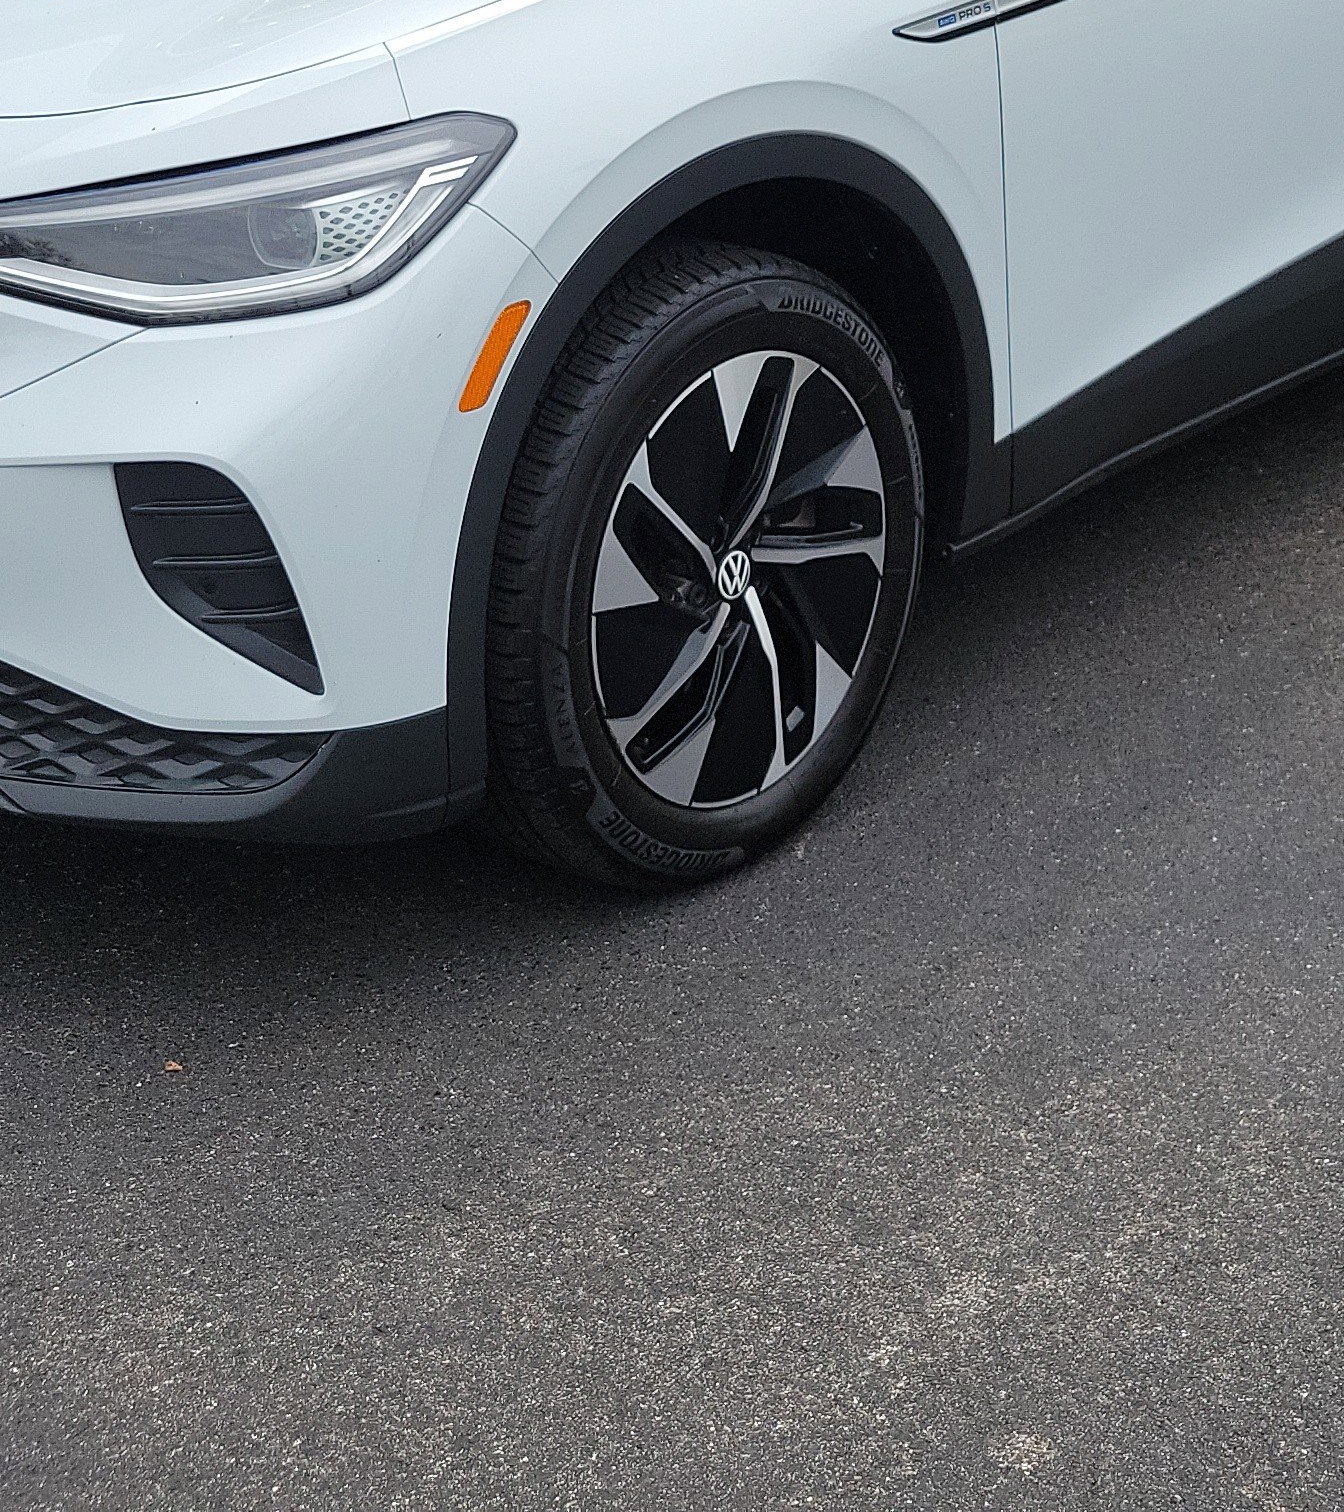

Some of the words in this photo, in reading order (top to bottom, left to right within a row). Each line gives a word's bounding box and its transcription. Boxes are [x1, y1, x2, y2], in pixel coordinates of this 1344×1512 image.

[958, 5, 981, 20] PRO
[983, 2, 991, 12] S
[718, 550, 750, 600] VW
